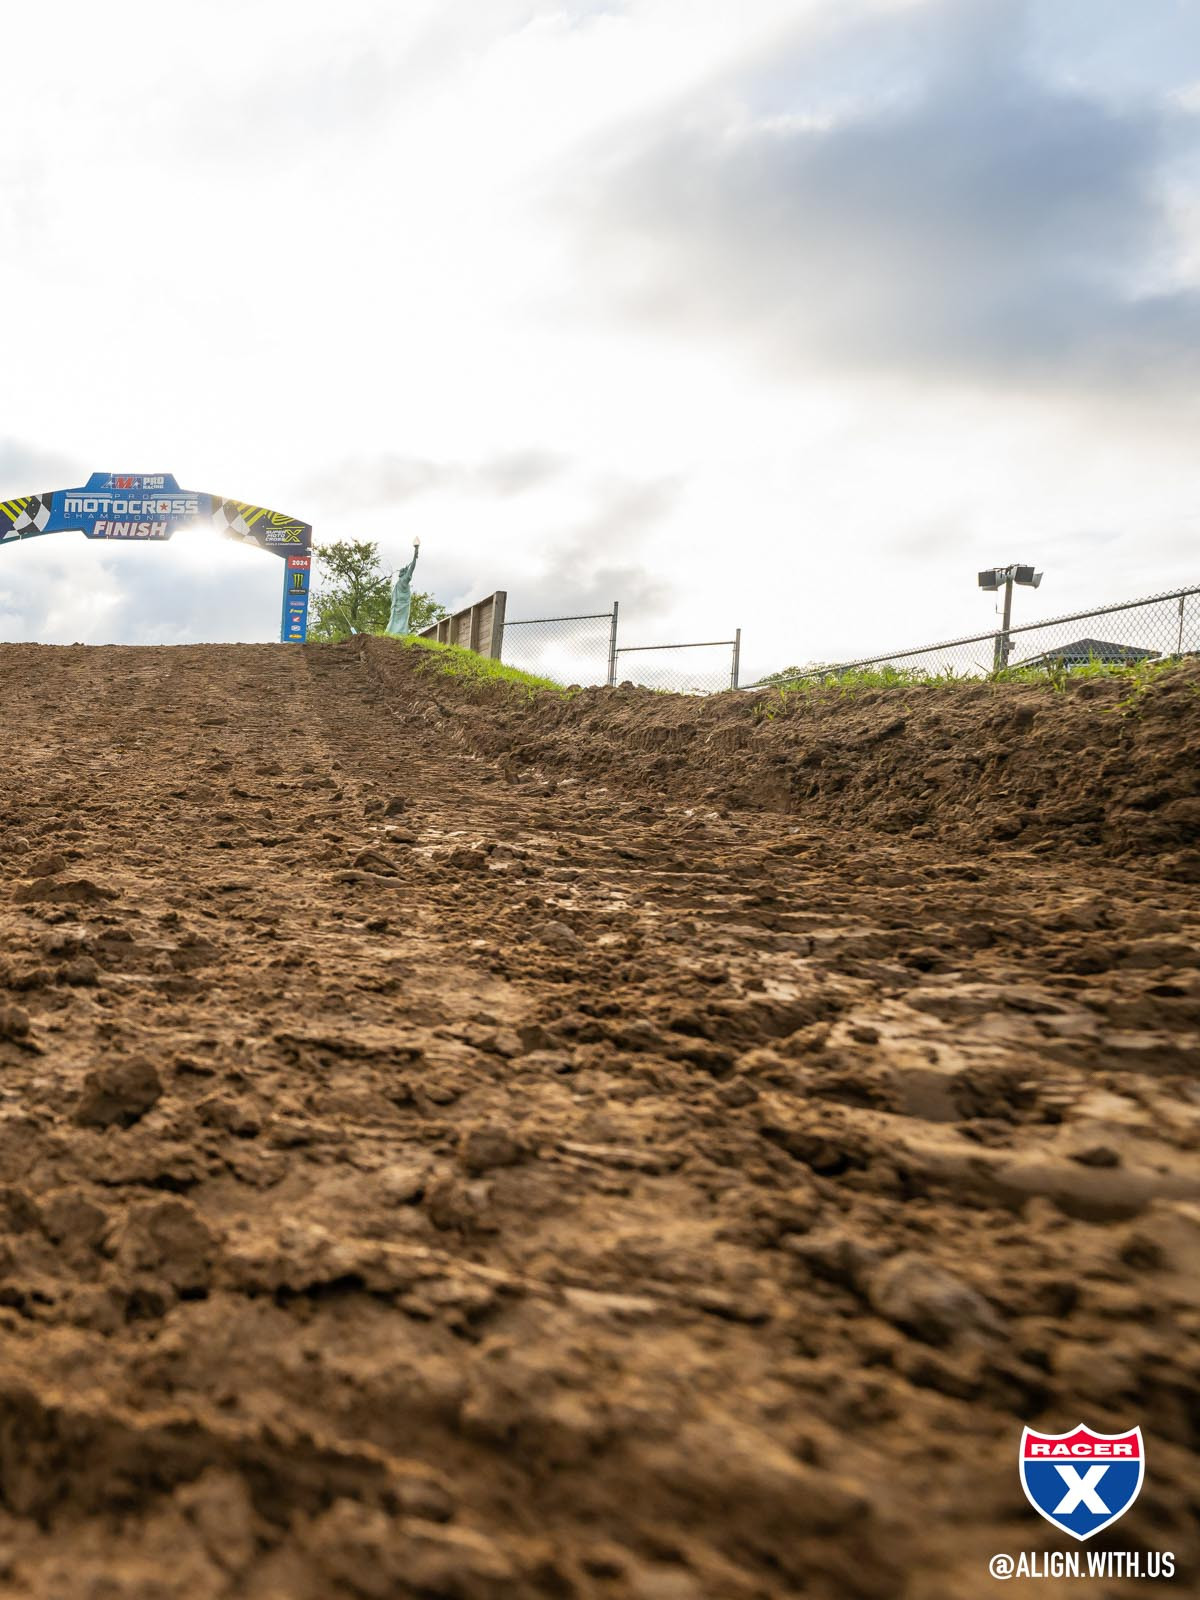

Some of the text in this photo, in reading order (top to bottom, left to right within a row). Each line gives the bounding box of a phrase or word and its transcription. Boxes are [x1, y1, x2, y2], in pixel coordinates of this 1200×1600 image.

[101, 477, 141, 489] AMA
[143, 477, 164, 485] PRO
[64, 499, 198, 514] MOTOCROSS
[94, 521, 167, 537] FINISH
